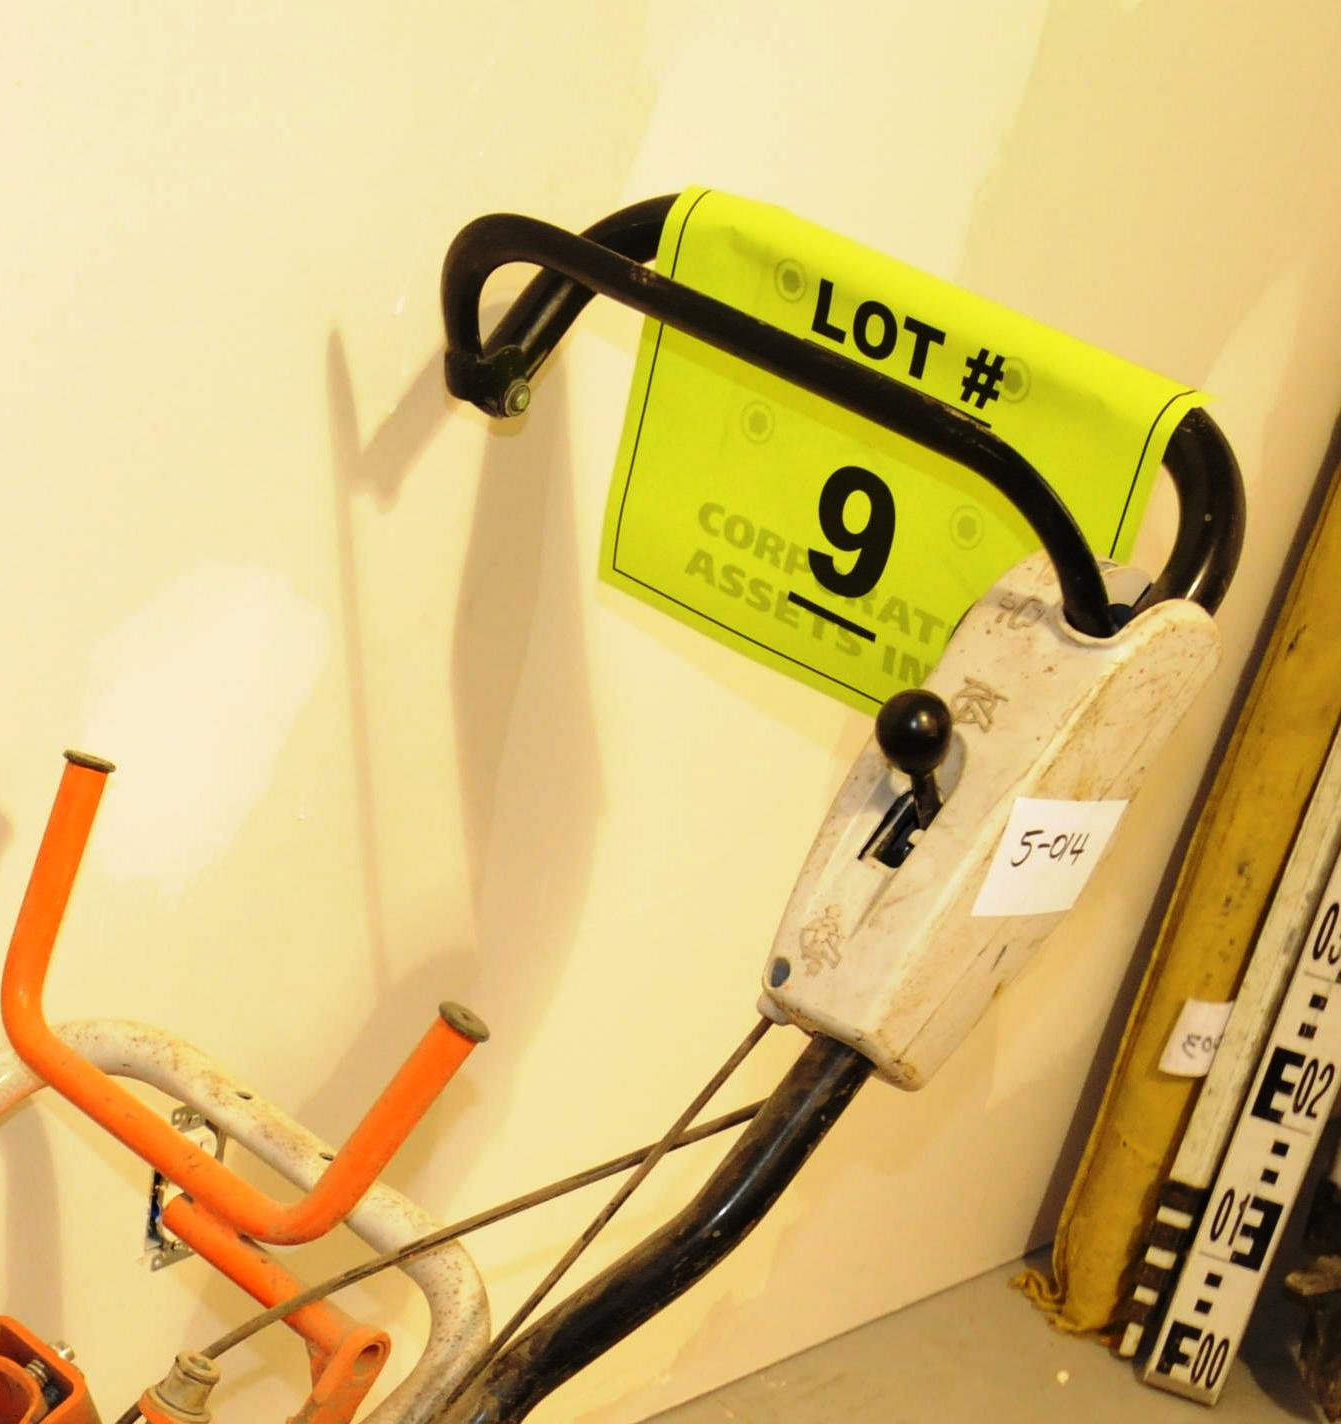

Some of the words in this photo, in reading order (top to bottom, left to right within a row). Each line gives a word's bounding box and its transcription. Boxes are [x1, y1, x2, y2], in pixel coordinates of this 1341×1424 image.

[811, 278, 946, 380] LOT
[960, 348, 1005, 410] #
[807, 465, 896, 599] 9
[1010, 829, 1090, 867] 5-014
